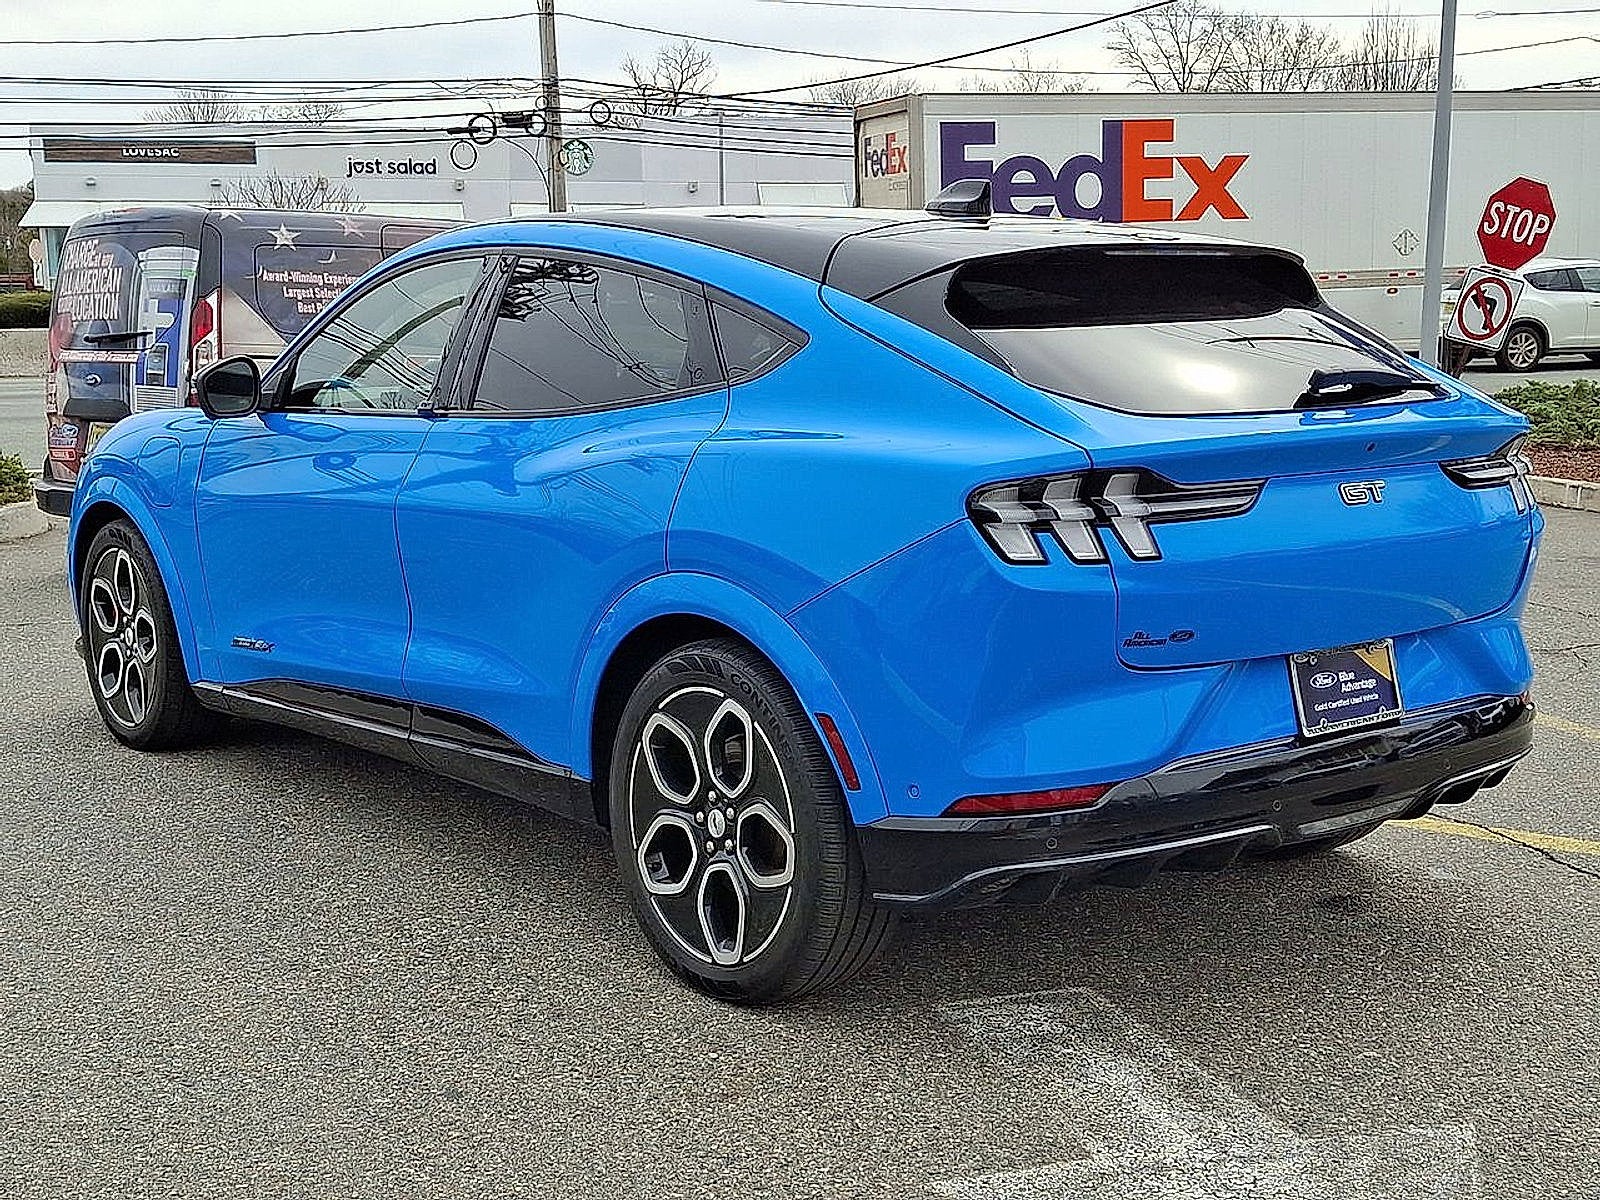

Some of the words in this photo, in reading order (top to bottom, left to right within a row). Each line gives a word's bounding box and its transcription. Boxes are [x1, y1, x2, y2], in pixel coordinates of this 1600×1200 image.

[122, 146, 180, 157] LOVESAC
[864, 132, 908, 178] FedEx
[387, 157, 437, 175] salad
[939, 119, 1250, 223] FedEx
[1483, 201, 1550, 246] STOP
[72, 292, 120, 320] LOCATION
[1338, 480, 1385, 506] GT
[1338, 671, 1356, 682] Blue
[1341, 678, 1378, 693] Advantage
